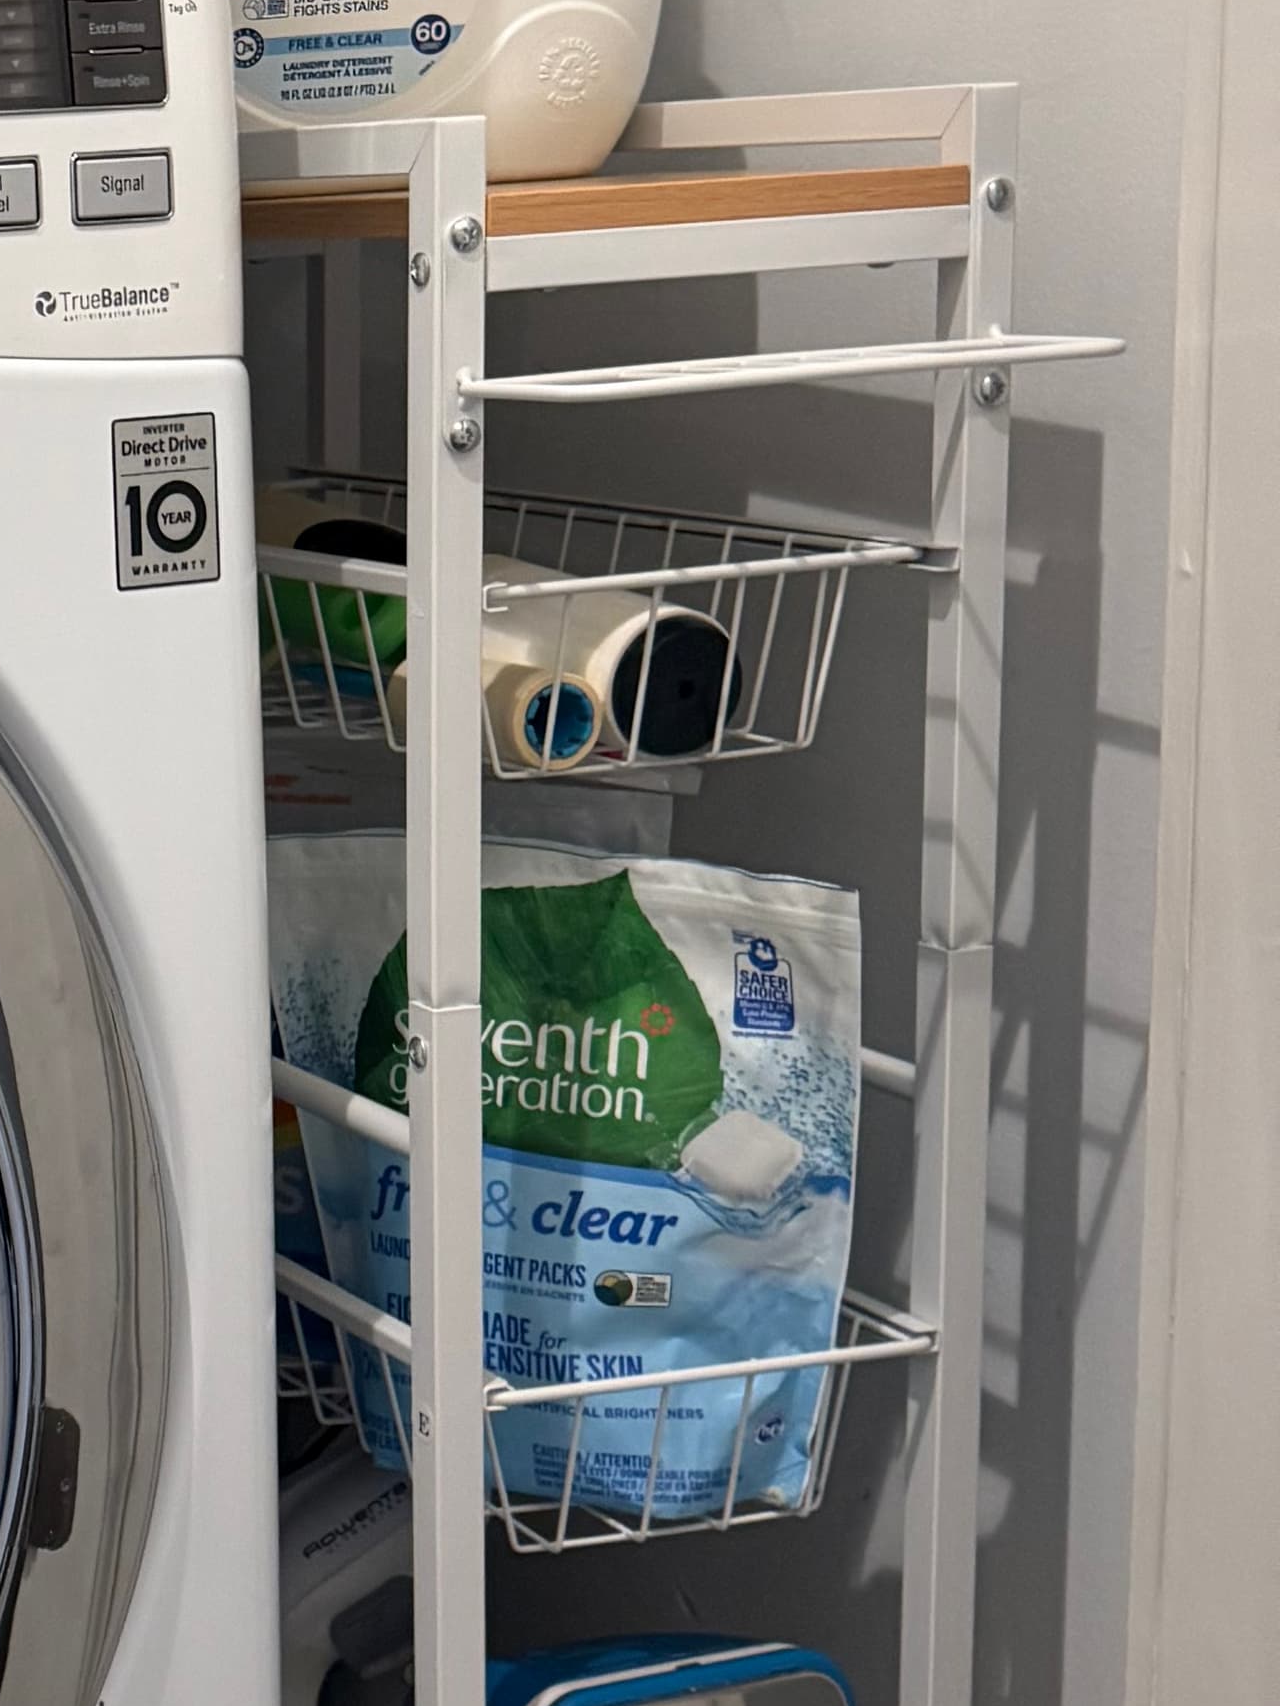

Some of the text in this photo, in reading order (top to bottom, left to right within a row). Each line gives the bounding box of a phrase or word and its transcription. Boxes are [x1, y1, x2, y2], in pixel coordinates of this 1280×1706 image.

[169, 4, 183, 15] Tag
[294, 1, 340, 17] FIGHTS
[343, 0, 389, 13] STAINS
[89, 22, 116, 35] Extra
[415, 21, 447, 42] 60
[288, 34, 383, 51] FREE & CLEAR
[283, 56, 393, 72] LAUNDRY DETERGENT
[100, 174, 144, 195] Signal
[143, 423, 185, 435] INVERTER
[121, 435, 208, 457] Direct Drive
[144, 455, 186, 467] MOTOR
[125, 479, 207, 556] 10
[161, 510, 192, 525] YEAR
[132, 559, 206, 576] WARRANTY
[739, 969, 788, 993] SAFER
[483, 1179, 517, 1231] &
[531, 1191, 678, 1247] clear
[529, 1256, 586, 1288] PACKS
[538, 1330, 567, 1351] for
[485, 1341, 643, 1383] ENSITIVE SKIN
[605, 1406, 704, 1420] BRIGHTNERS
[418, 1411, 430, 1437] E
